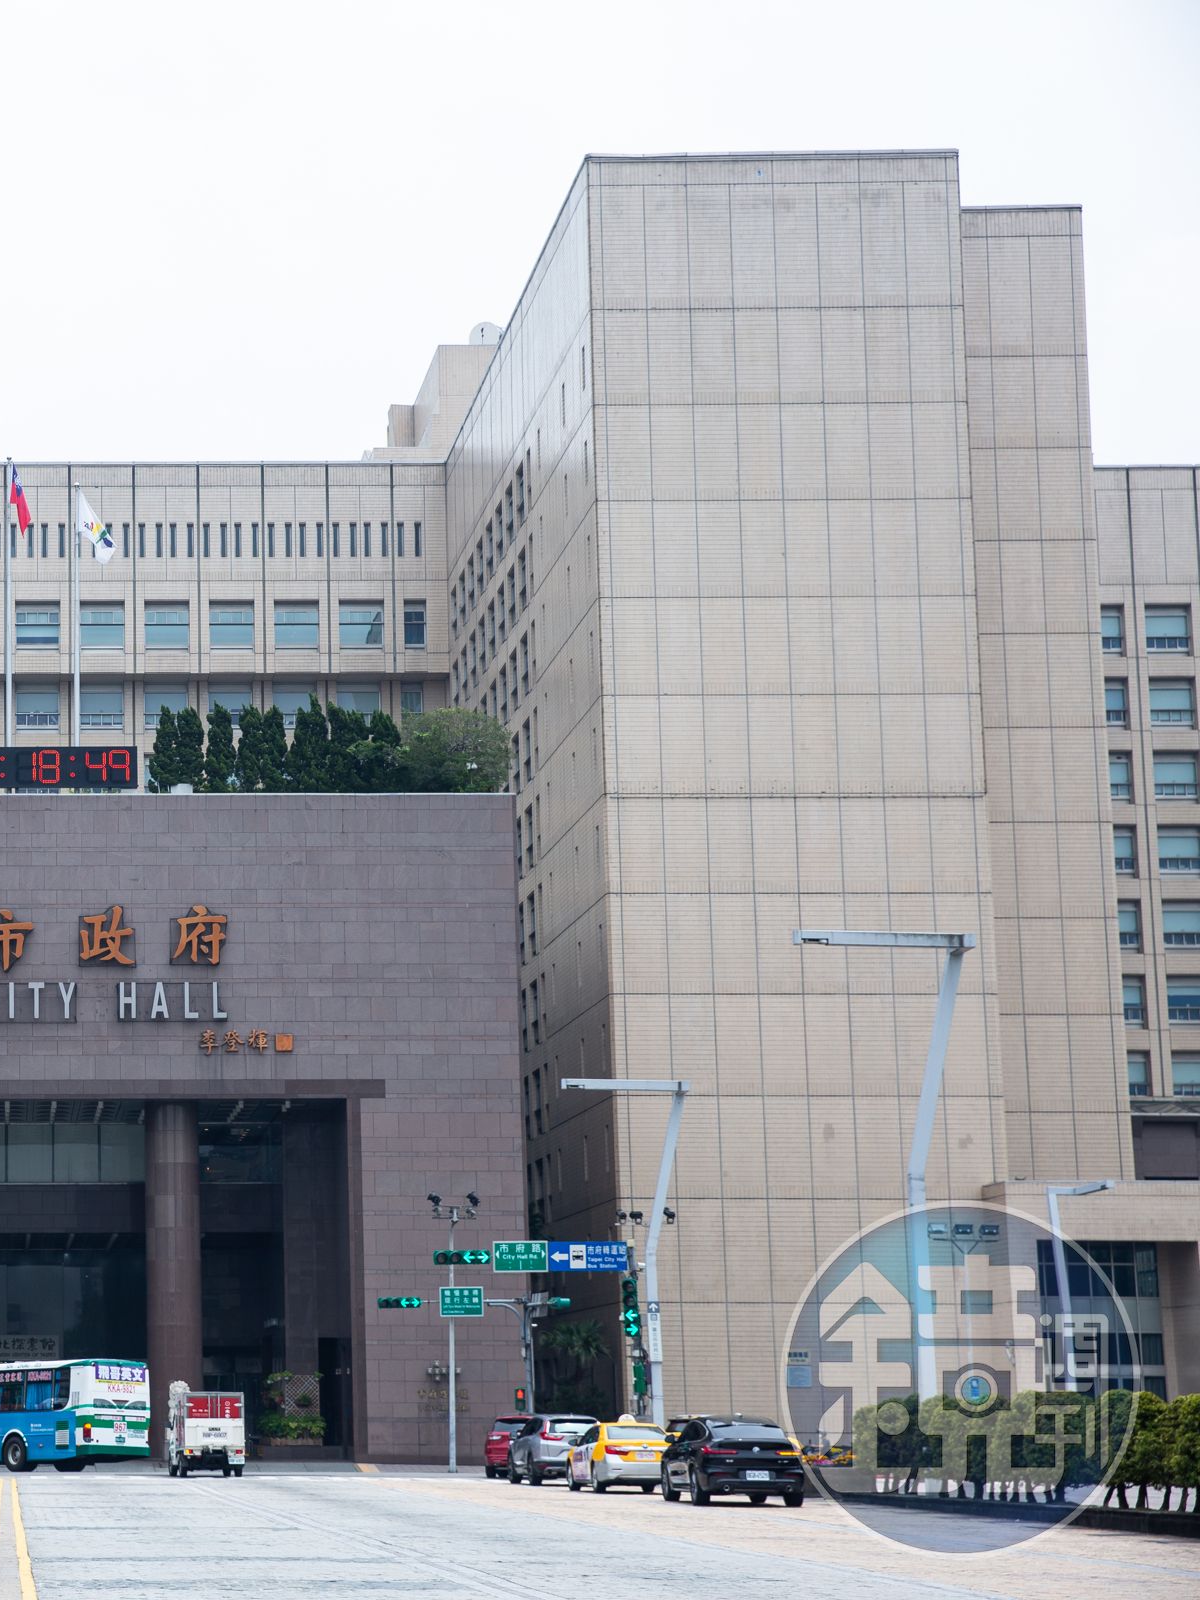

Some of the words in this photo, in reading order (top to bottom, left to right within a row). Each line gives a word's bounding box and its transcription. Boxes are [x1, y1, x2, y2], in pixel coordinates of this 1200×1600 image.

[118, 981, 228, 1020] HALL
[200, 1029, 268, 1056] 李登輝
[499, 1243, 541, 1253] 市府路
[114, 1422, 127, 1432] 967
